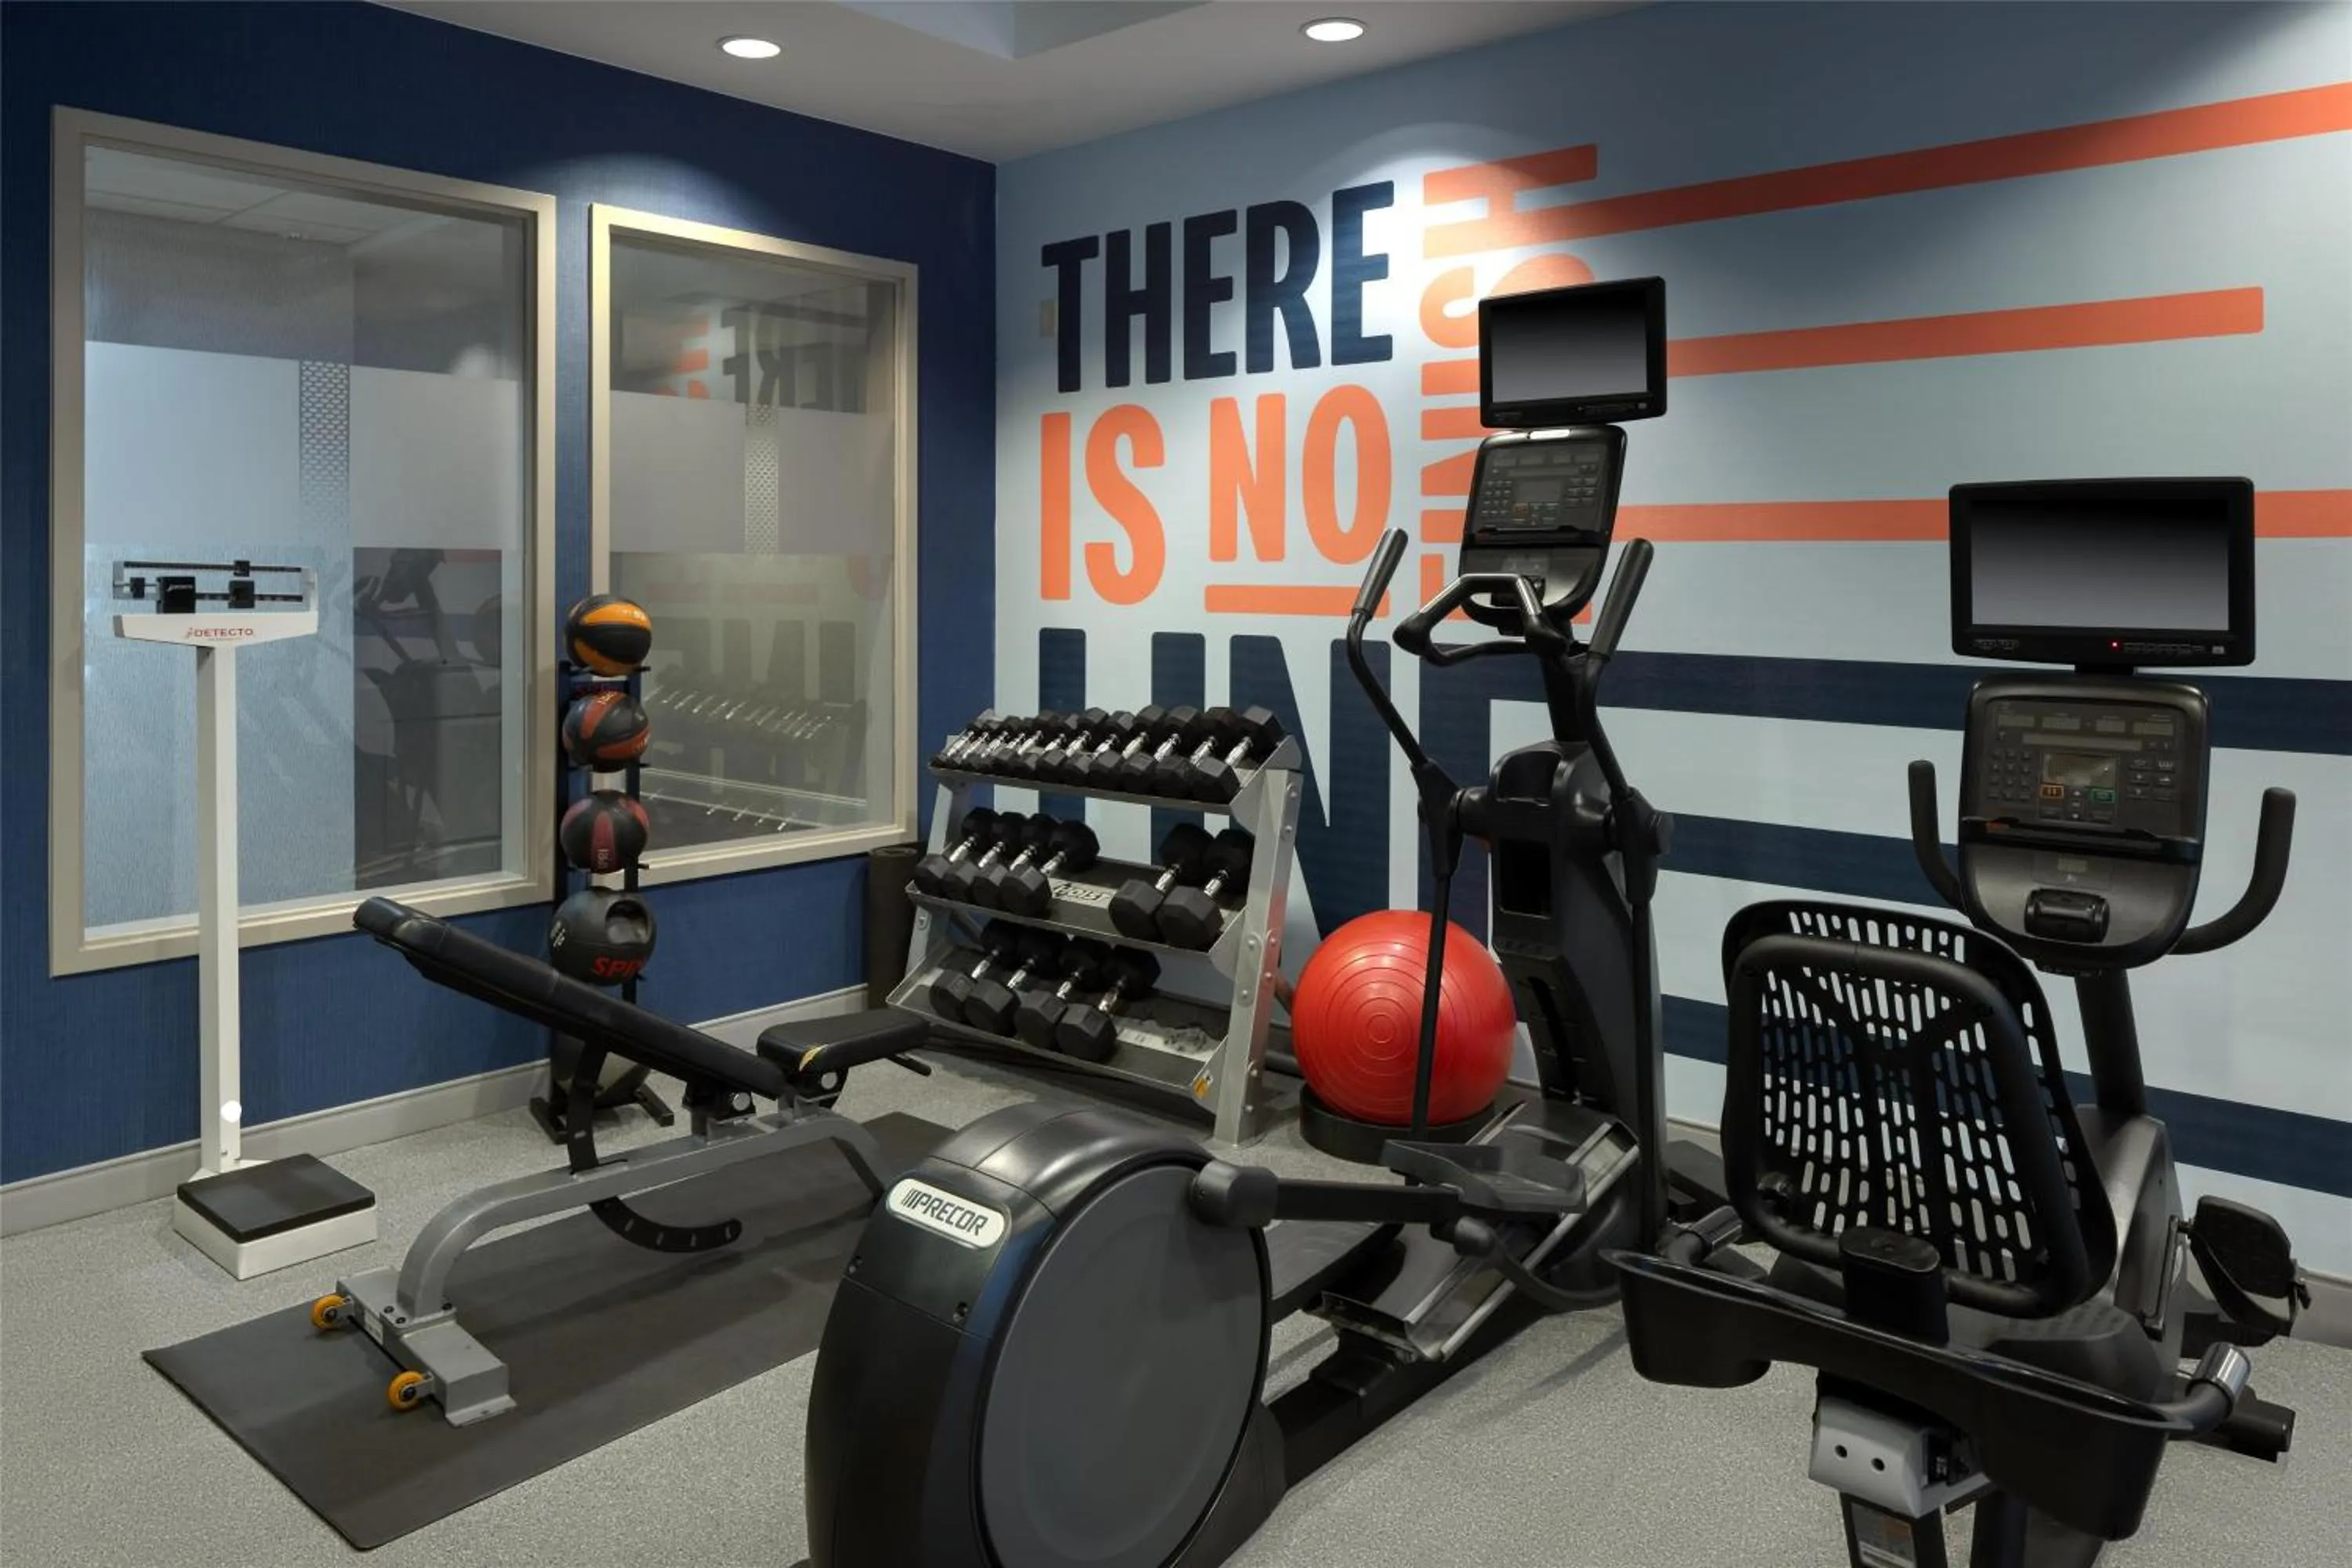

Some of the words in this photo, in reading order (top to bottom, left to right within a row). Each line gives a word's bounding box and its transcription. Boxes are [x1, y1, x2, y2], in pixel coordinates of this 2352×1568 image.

[1040, 180, 1395, 394] THERE
[1040, 403, 1166, 606] IS
[1208, 383, 1392, 565] NO
[194, 628, 254, 637] DETECTO
[912, 1192, 989, 1236] PRECOR
